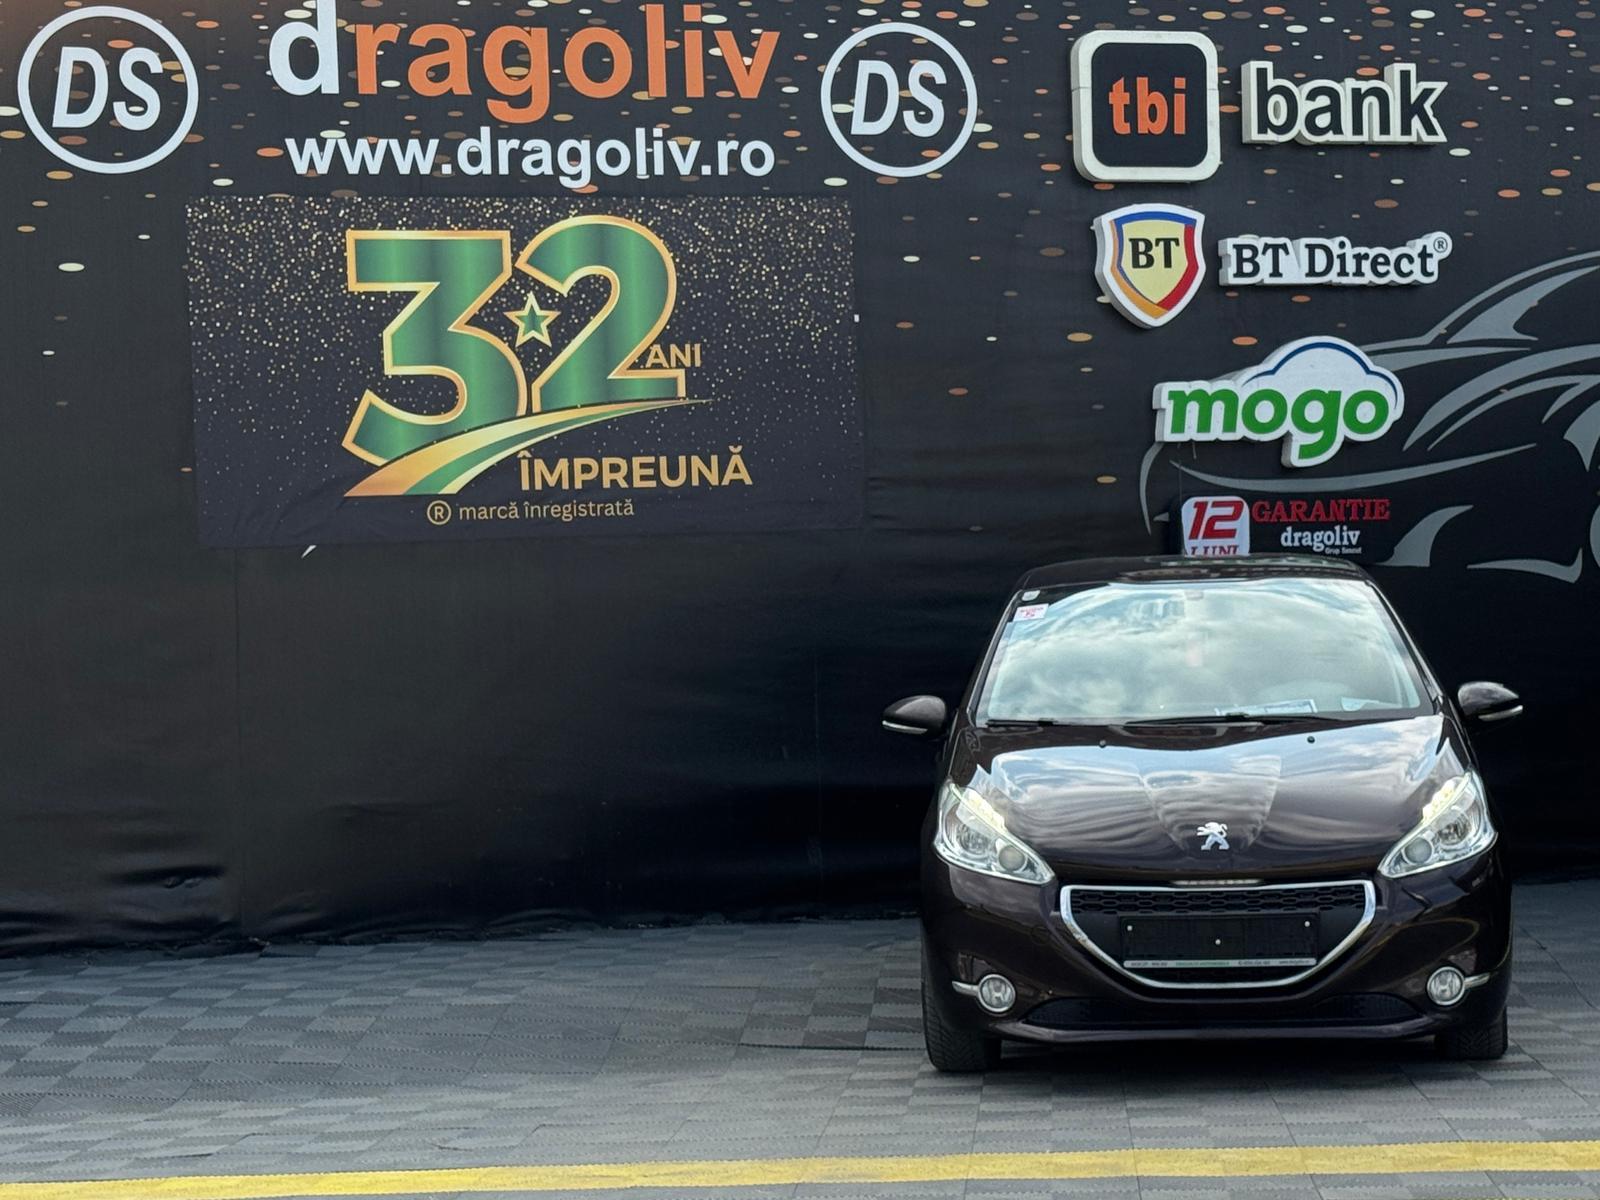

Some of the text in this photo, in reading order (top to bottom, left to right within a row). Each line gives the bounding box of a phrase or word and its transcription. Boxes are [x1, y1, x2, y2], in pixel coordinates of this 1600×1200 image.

[269, 0, 779, 122] dragoliv
[51, 46, 162, 130] DS
[850, 59, 947, 138] DS
[1108, 65, 1443, 137] tbi bank
[285, 126, 776, 188] www.dragoliv.ro
[1129, 238, 1180, 269] BT
[1232, 243, 1290, 278] BT
[342, 214, 687, 466] 32
[645, 343, 701, 368] ANI
[1168, 388, 1389, 460] mogo
[517, 445, 753, 490] ÎMPREUNĂ
[458, 504, 520, 521] marcă
[524, 500, 635, 520] înregistrată
[1188, 499, 1391, 540] 12 GARANTIE
[1280, 525, 1361, 553] dragoliv
